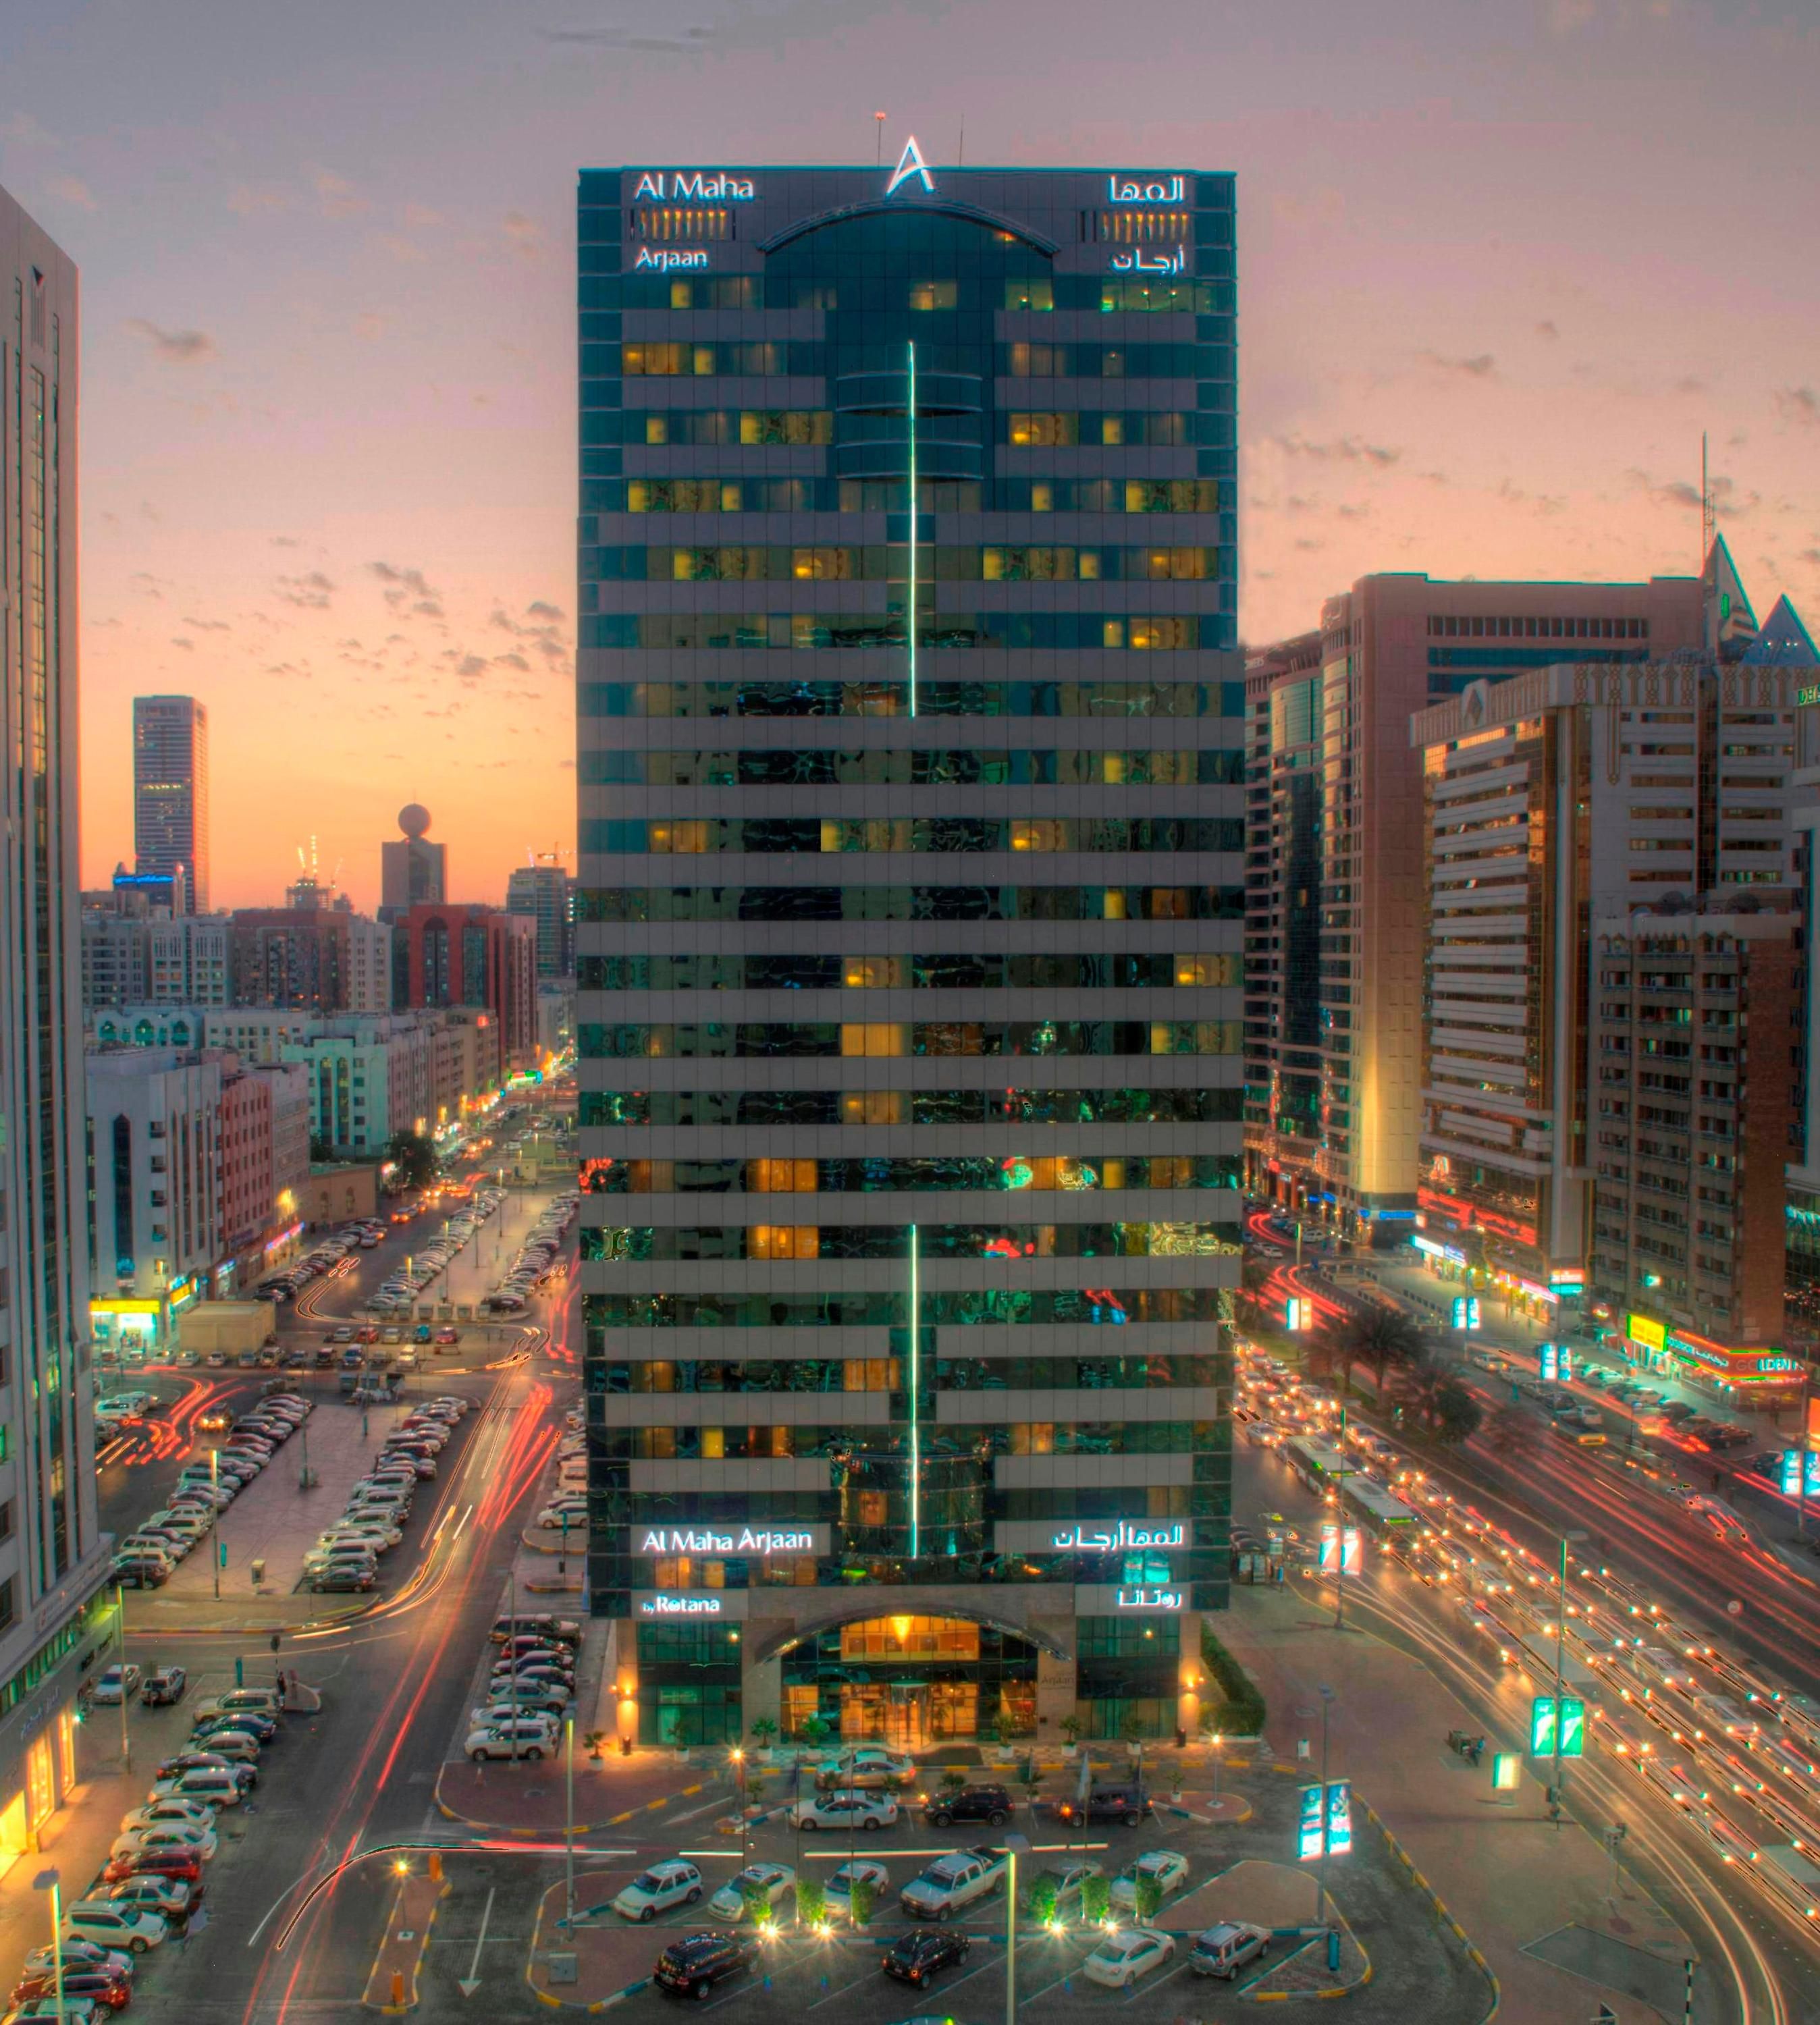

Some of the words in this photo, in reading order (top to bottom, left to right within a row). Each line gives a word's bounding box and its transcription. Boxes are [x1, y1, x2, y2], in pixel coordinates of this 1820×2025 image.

[635, 173, 666, 200] Al
[673, 172, 755, 201] Maha
[1108, 175, 1185, 202] المها
[635, 246, 708, 273] Arjaan
[1113, 244, 1184, 275] أرجان
[643, 1531, 666, 1550] Al
[672, 1531, 732, 1551] Maha
[738, 1528, 811, 1554] Arjaan
[1053, 1520, 1124, 1550] أرجان
[1127, 1524, 1183, 1546] المها
[642, 1602, 654, 1614] by
[656, 1594, 720, 1612] Rotana
[1117, 1588, 1181, 1608] روتانا
